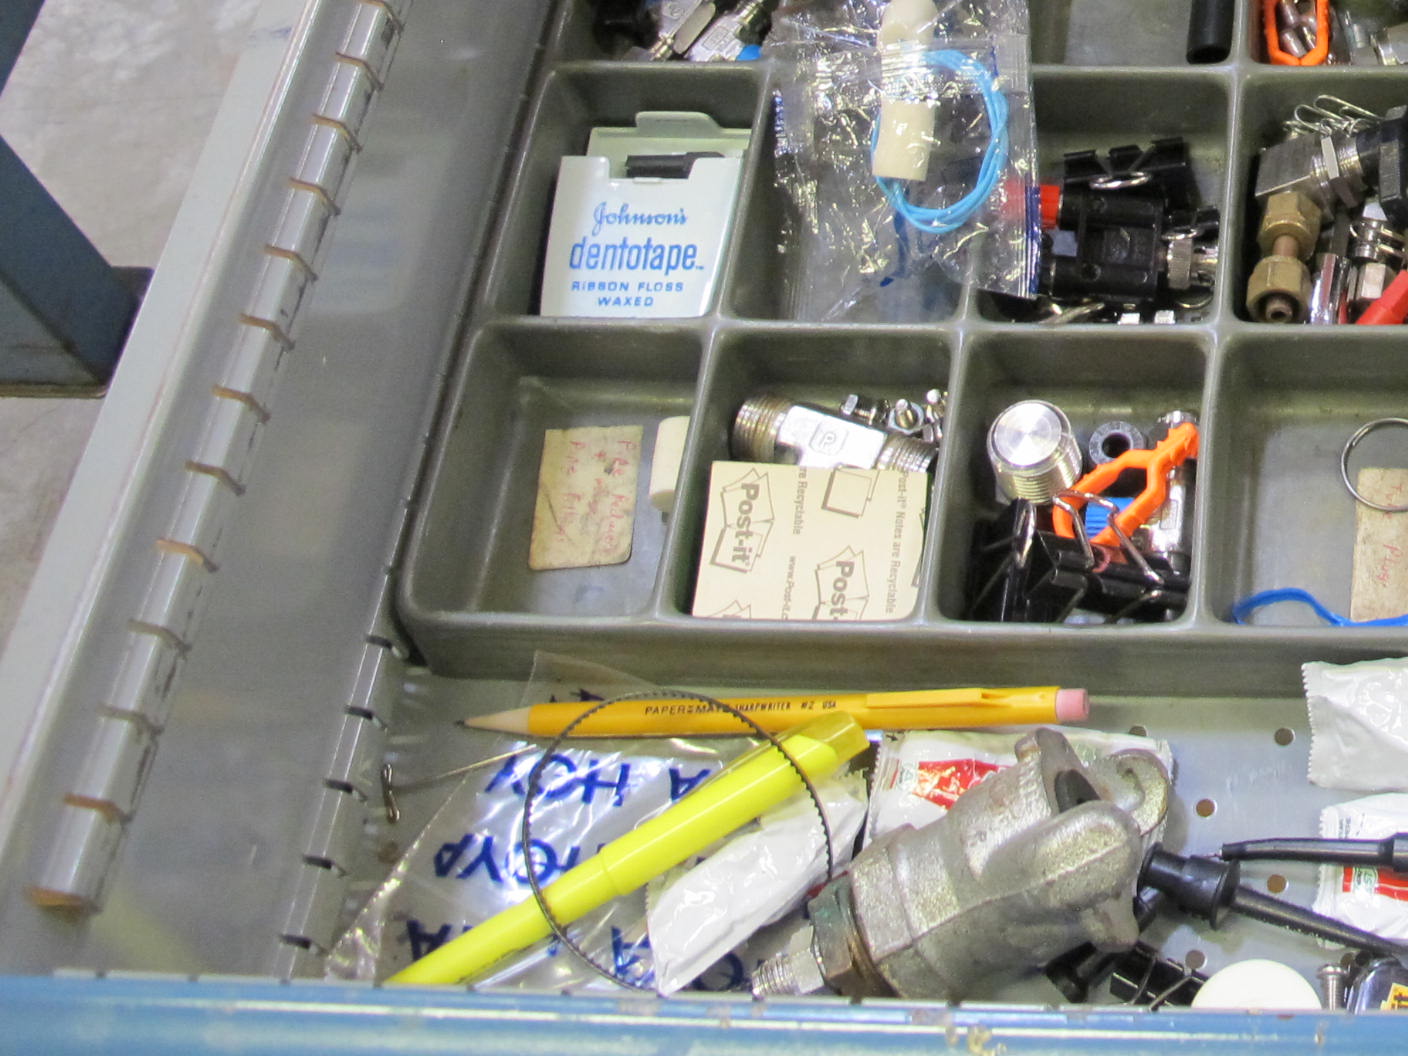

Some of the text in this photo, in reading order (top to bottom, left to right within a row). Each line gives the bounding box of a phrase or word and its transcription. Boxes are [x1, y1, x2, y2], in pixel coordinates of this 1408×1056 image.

[591, 200, 688, 237] Johnson's
[568, 236, 699, 276] dentotape
[571, 281, 685, 292] RIBBON FLOSS
[597, 296, 655, 307] WAXED
[792, 478, 808, 535] Recyclable
[895, 511, 906, 539] Notes
[893, 540, 902, 558] are
[885, 559, 900, 615] Recyclable
[822, 701, 837, 709] USA
